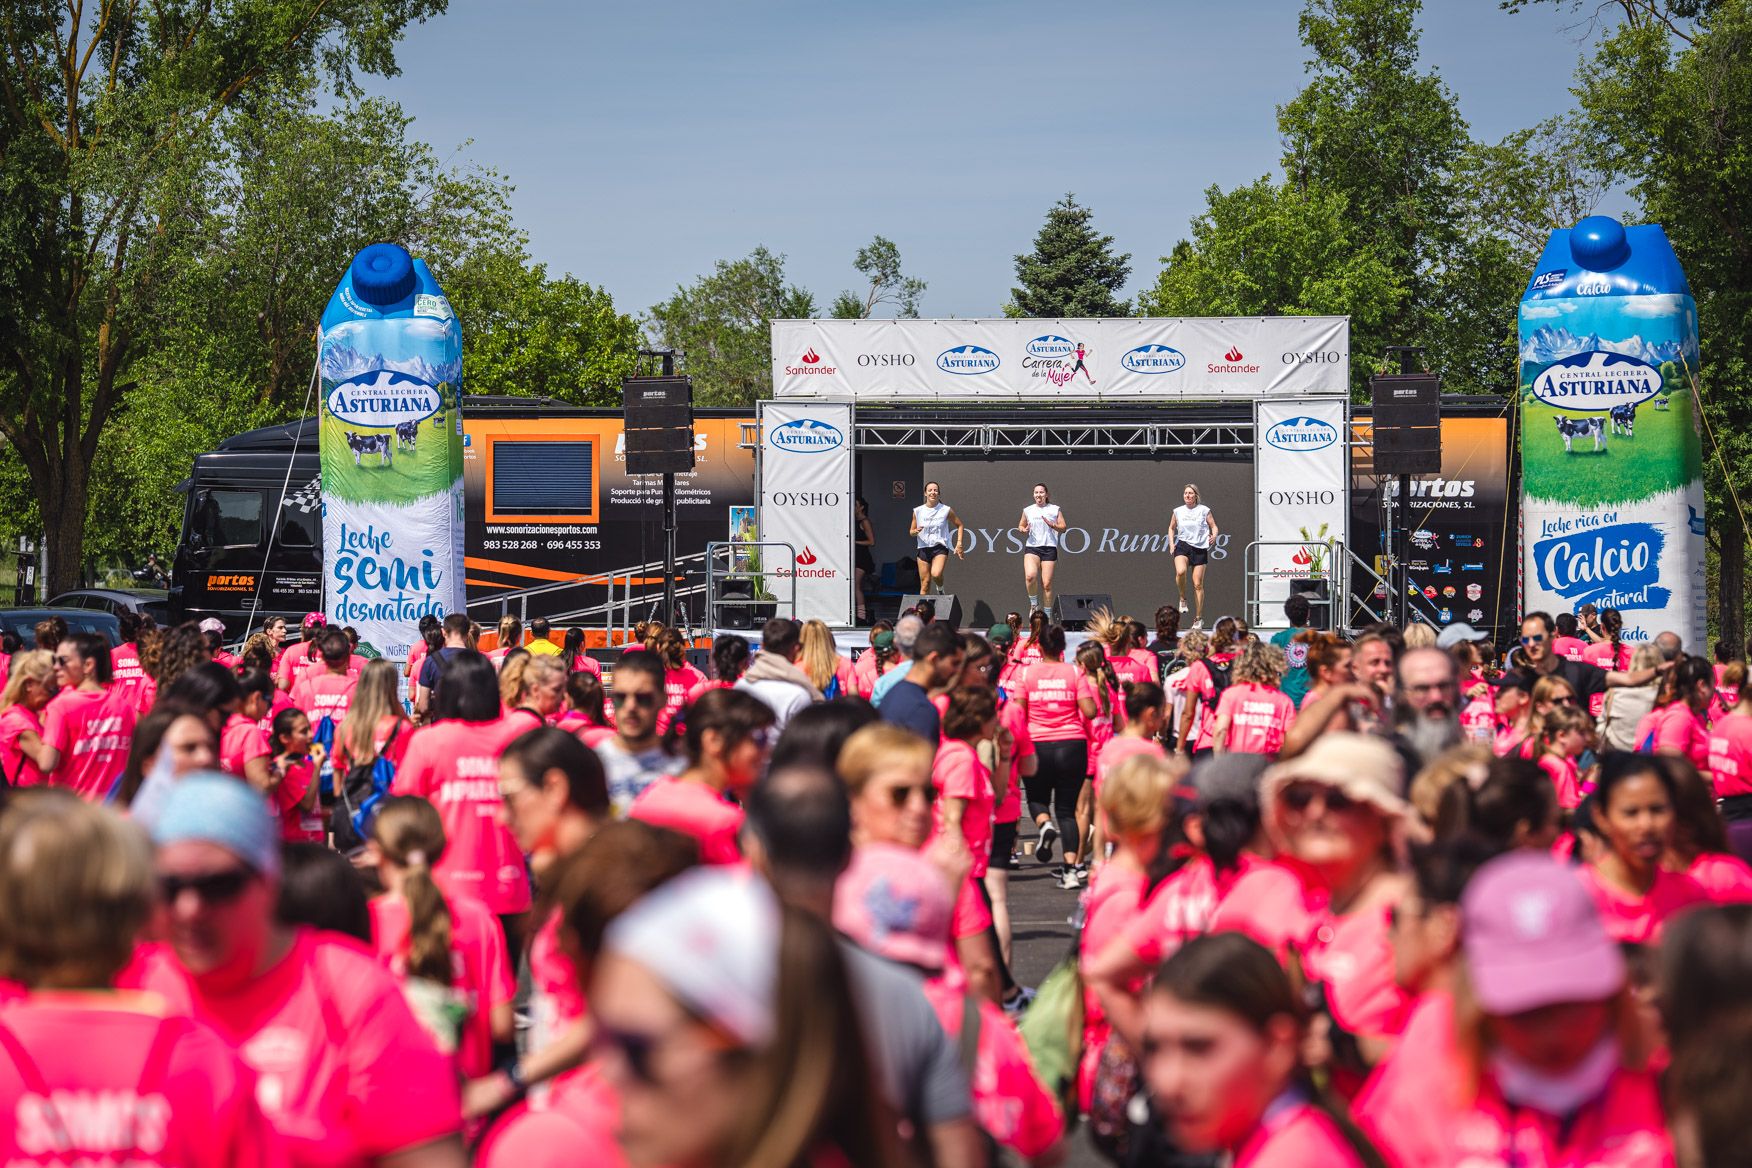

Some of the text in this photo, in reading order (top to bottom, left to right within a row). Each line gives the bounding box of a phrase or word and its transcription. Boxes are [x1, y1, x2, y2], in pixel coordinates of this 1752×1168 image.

[1534, 273, 1550, 286] PLS
[1030, 344, 1071, 352] ASTURIANA
[858, 354, 915, 366] OYSHO
[942, 356, 996, 368] ASTURIANA
[1022, 356, 1062, 368] Carrera
[1127, 356, 1180, 366] ASTURIANA
[1282, 352, 1340, 365] OYSHO
[786, 366, 836, 376] Santander
[1208, 363, 1260, 374] Santander
[1045, 367, 1077, 386] Mujer
[1540, 375, 1652, 398] ASTURIANA
[334, 391, 432, 413] ASTURIANA
[776, 431, 837, 444] ASTURIANA
[1272, 430, 1332, 442] ASTURIANA
[774, 492, 839, 506] OYSHO
[1270, 491, 1334, 506] OYSHO
[486, 524, 598, 536] www.sonorizacionesportos.com
[1540, 512, 1618, 538] Leche rica en
[336, 523, 394, 558] Leche
[484, 540, 600, 550] 983 528 268 696 455 353
[948, 528, 1090, 554] OYSO
[1544, 537, 1649, 590] Calcio
[334, 548, 442, 595] semi
[208, 575, 254, 586] portos
[1586, 585, 1648, 609] natural
[335, 592, 445, 623] desnatada
[386, 644, 411, 656] INGRED
